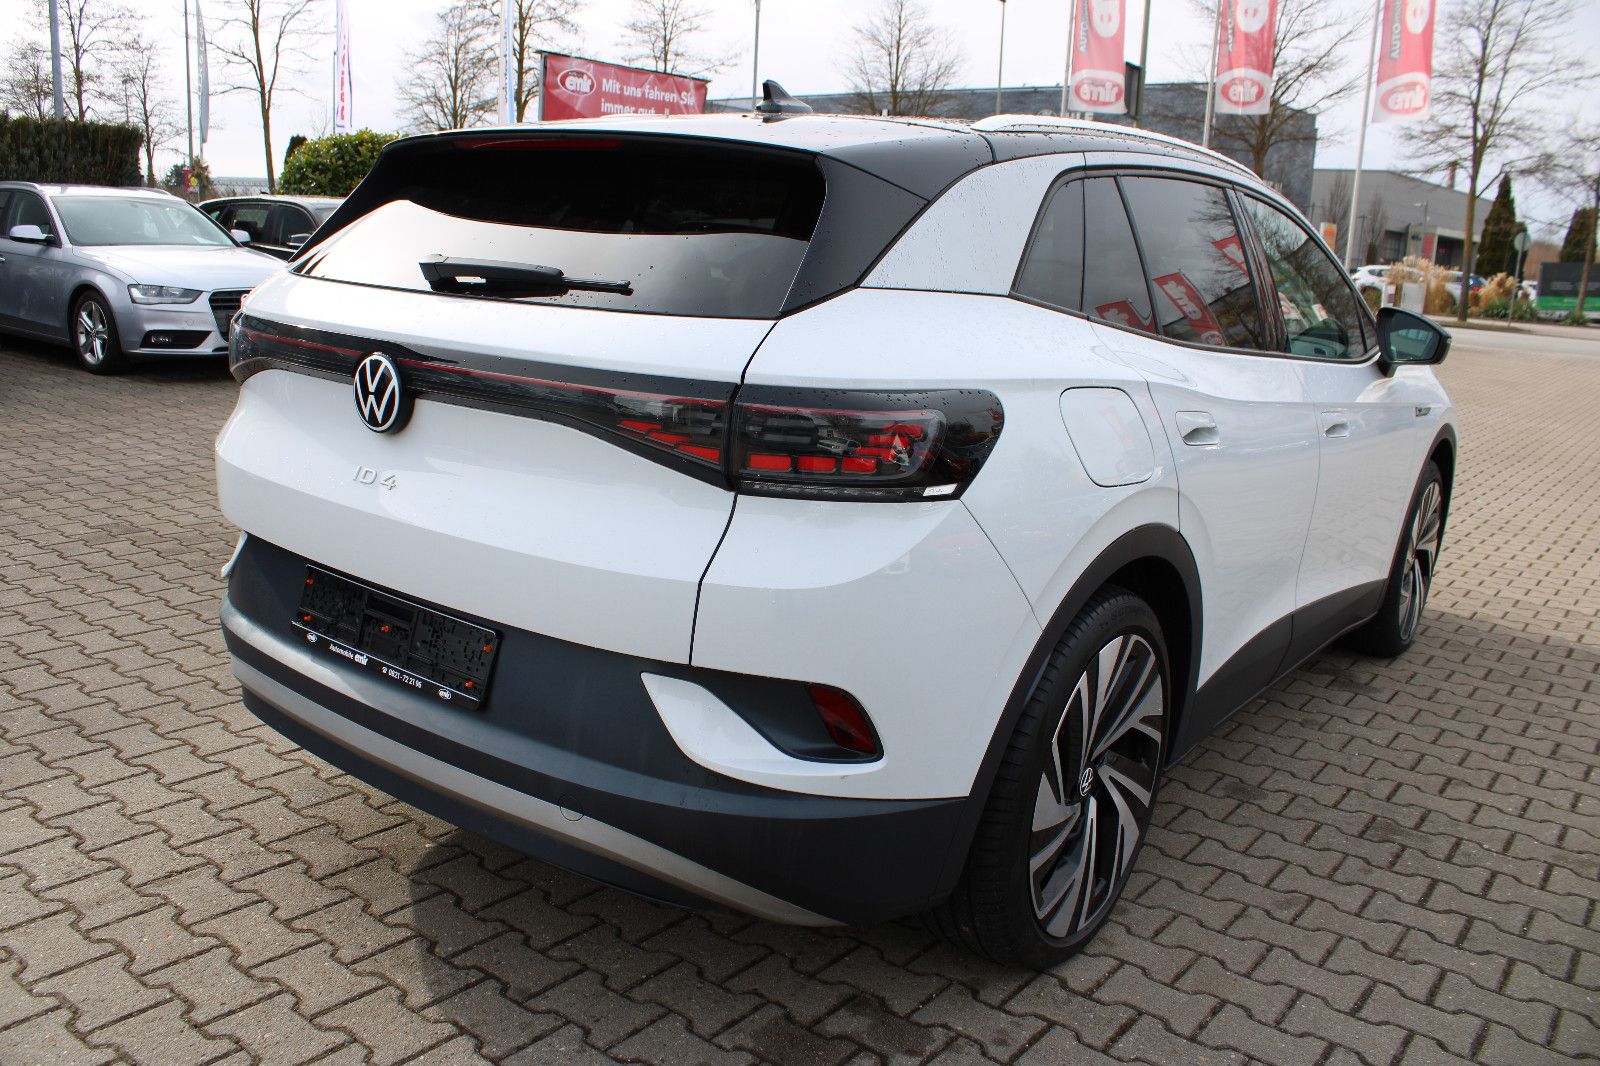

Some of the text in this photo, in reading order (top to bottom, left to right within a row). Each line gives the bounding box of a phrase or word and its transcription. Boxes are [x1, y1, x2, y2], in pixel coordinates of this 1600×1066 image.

[565, 74, 592, 93] emir
[602, 79, 621, 95] Mit
[624, 86, 642, 97] uns
[645, 85, 677, 103] fahren
[1080, 82, 1119, 102] emir
[329, 643, 369, 666] Automobile emir
